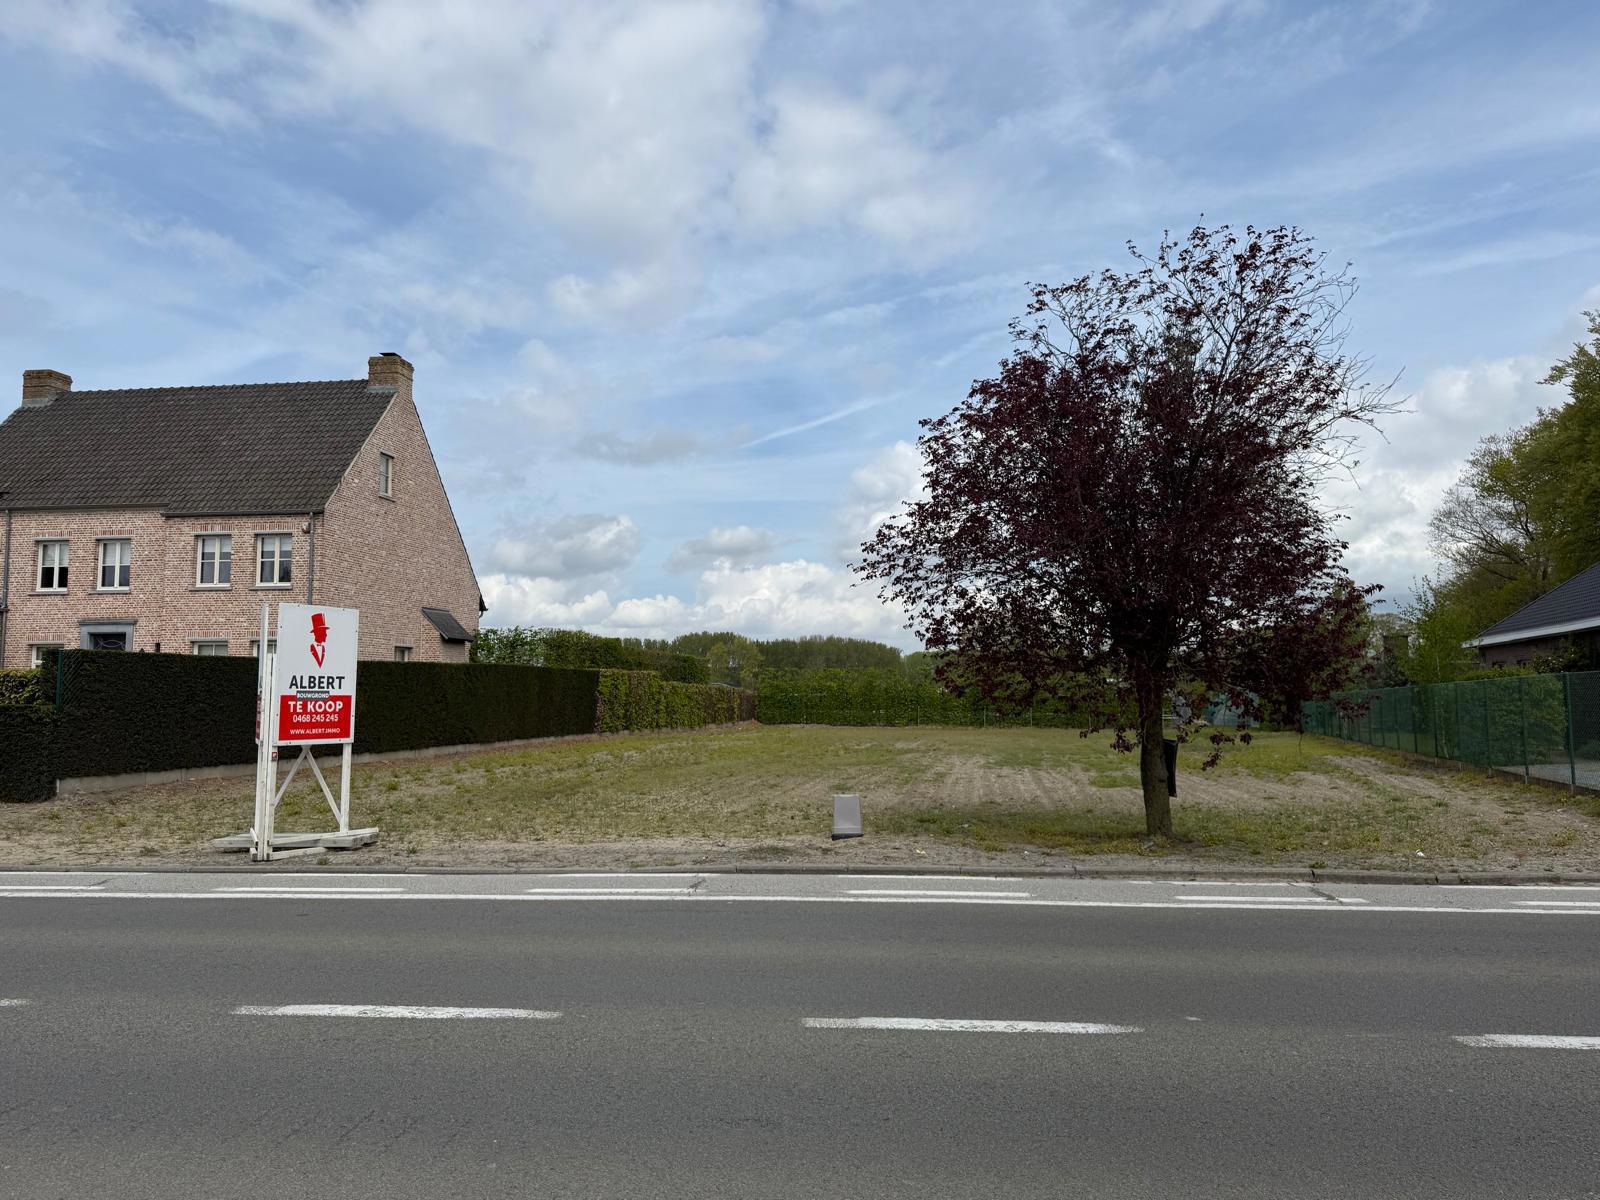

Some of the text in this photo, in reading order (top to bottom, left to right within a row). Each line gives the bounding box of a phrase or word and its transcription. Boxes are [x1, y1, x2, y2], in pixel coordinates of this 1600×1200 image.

[289, 675, 345, 689] ALBERT
[288, 701, 343, 713] TE KOOP
[292, 714, 339, 723] 0468 245 245
